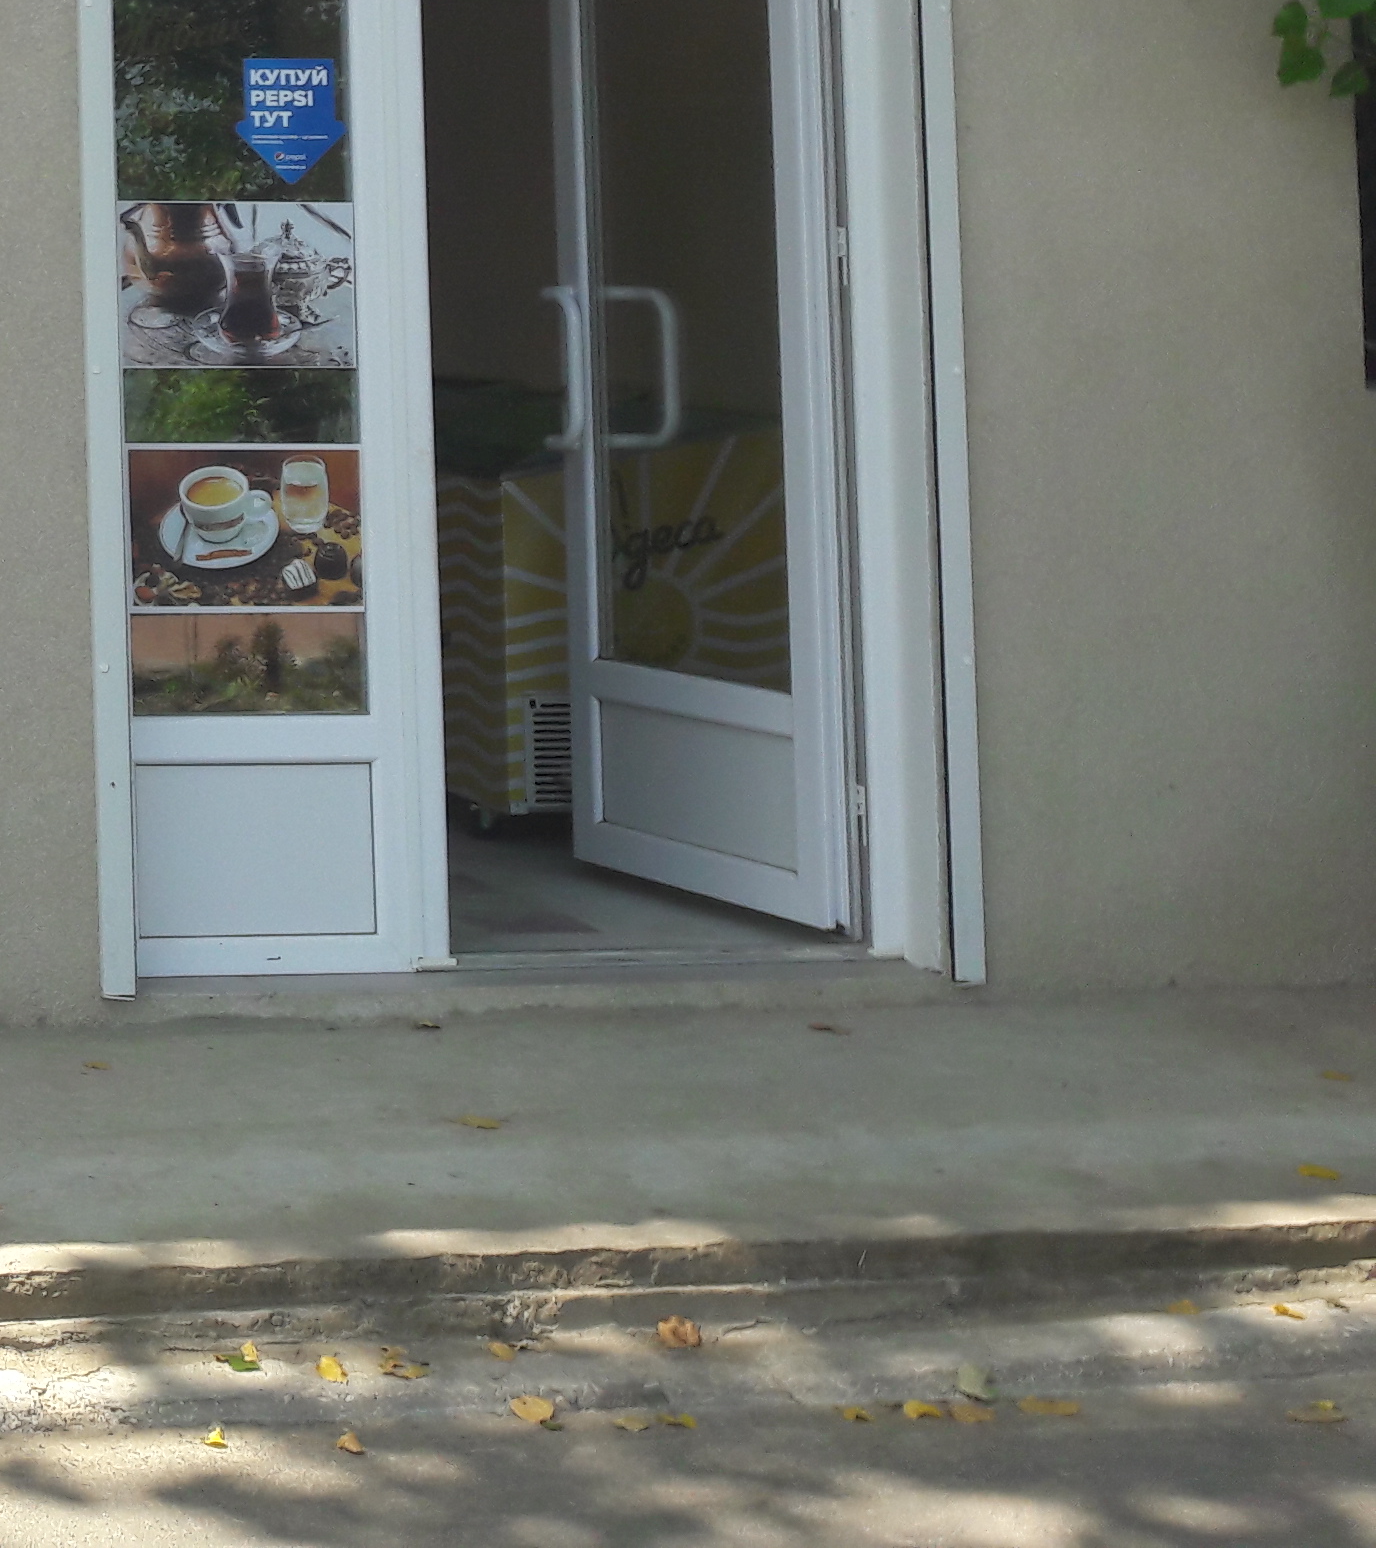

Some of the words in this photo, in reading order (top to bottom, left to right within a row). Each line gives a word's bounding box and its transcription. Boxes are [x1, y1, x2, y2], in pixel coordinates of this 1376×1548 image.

[249, 65, 329, 86] КУПУЙ
[250, 90, 314, 107] PEPSI
[250, 111, 293, 128] ТУТ
